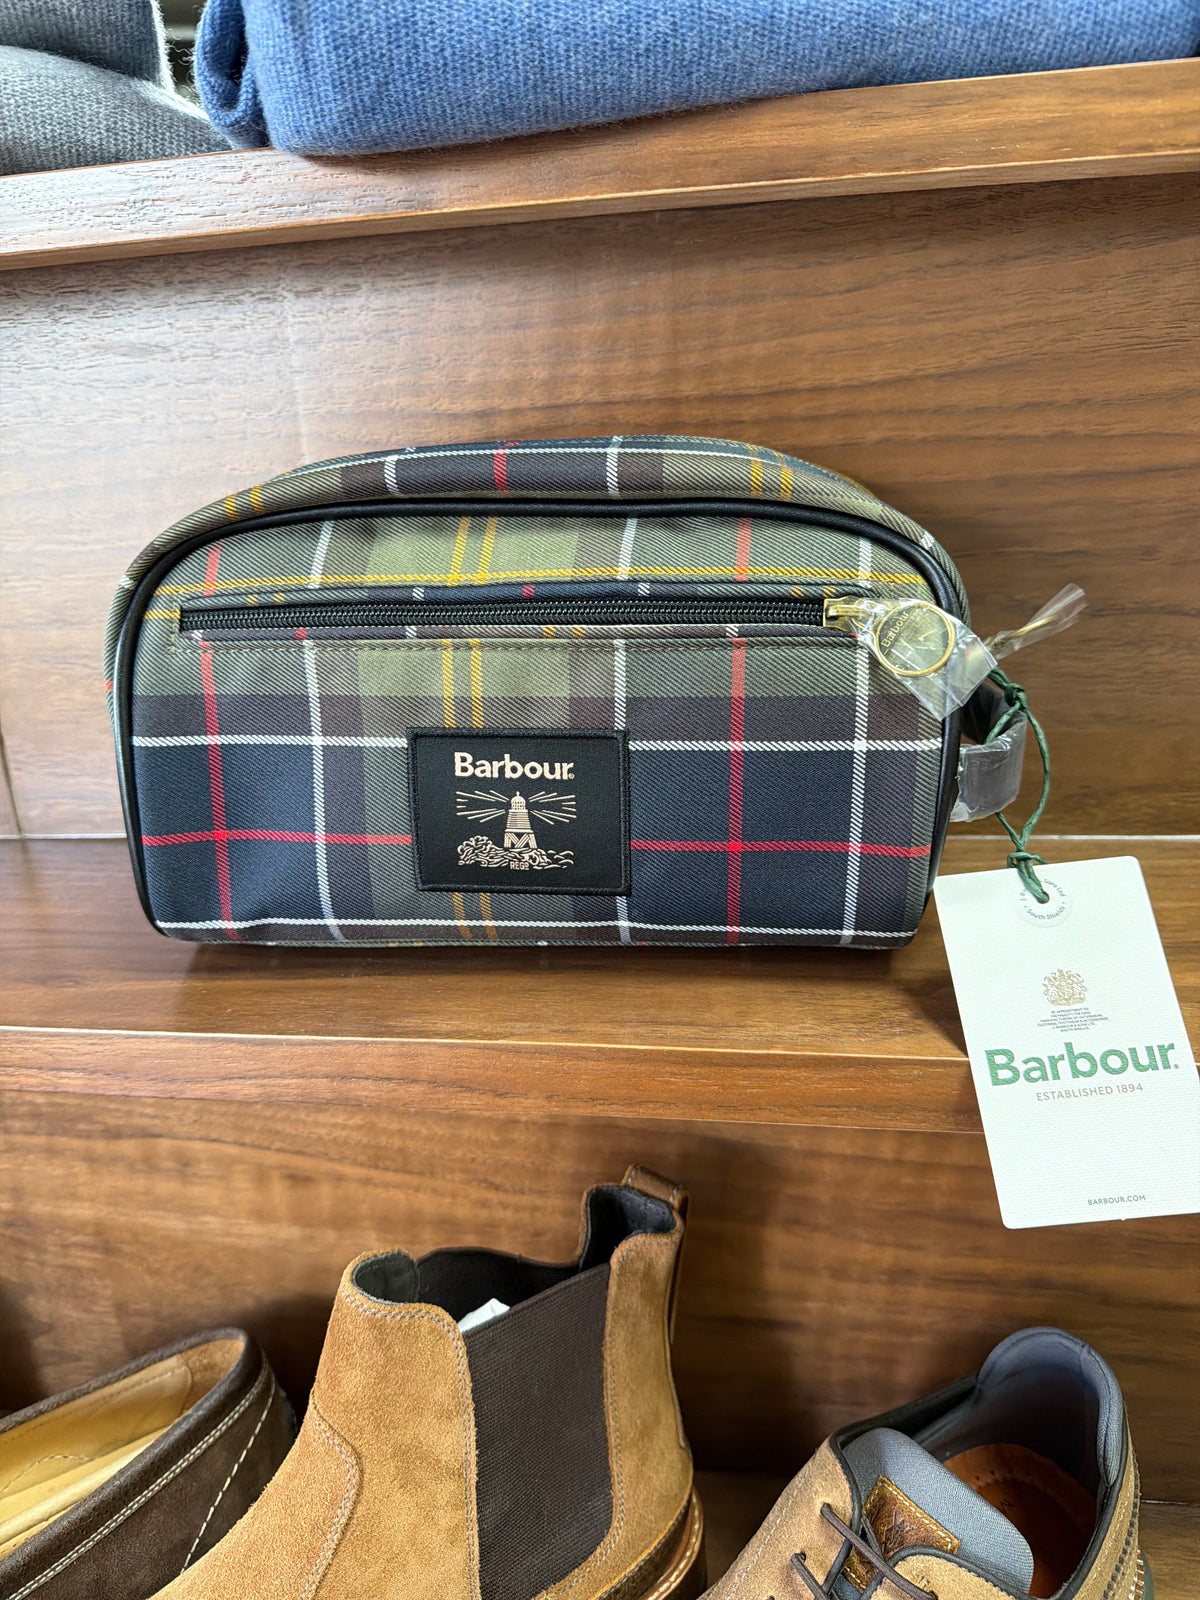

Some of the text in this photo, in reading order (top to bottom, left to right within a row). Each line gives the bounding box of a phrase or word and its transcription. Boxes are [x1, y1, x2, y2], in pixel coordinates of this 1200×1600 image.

[1036, 1083, 1144, 1101] ESTABLISHED 1894
[1087, 1194, 1147, 1206] BARBOUR.COM
